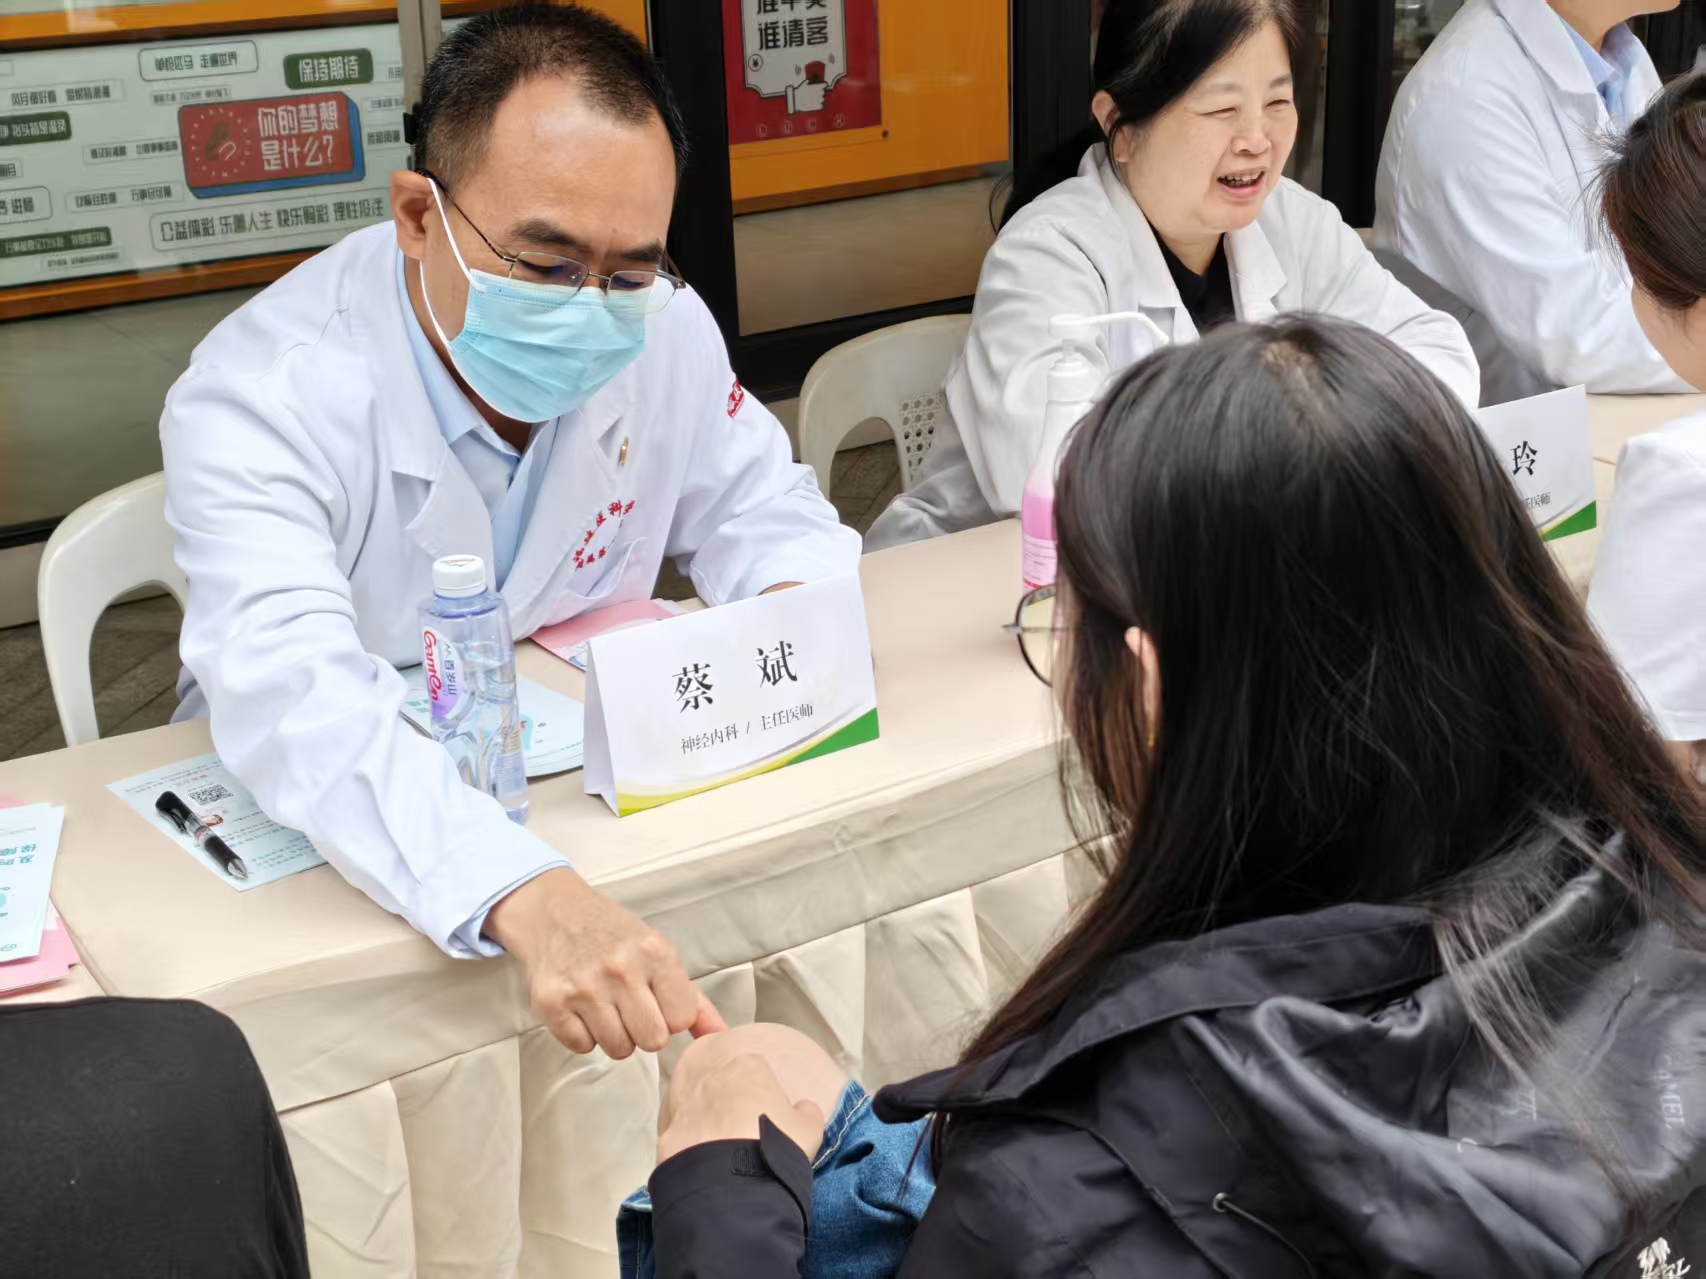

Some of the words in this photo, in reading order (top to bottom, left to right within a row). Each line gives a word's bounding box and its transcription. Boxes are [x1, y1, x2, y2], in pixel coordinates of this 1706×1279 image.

[759, 16, 829, 51] 谁请客
[299, 55, 360, 83] 保持期待
[258, 100, 339, 136] 你的梦想
[277, 203, 329, 228] 快乐购彩
[333, 197, 384, 221] 理性投注
[1510, 440, 1538, 476] 玲
[443, 659, 458, 696] 百岁山
[672, 663, 714, 714] 蔡
[755, 641, 798, 689] 斌
[680, 722, 739, 755] 神经内科
[760, 703, 814, 732] 主任医师
